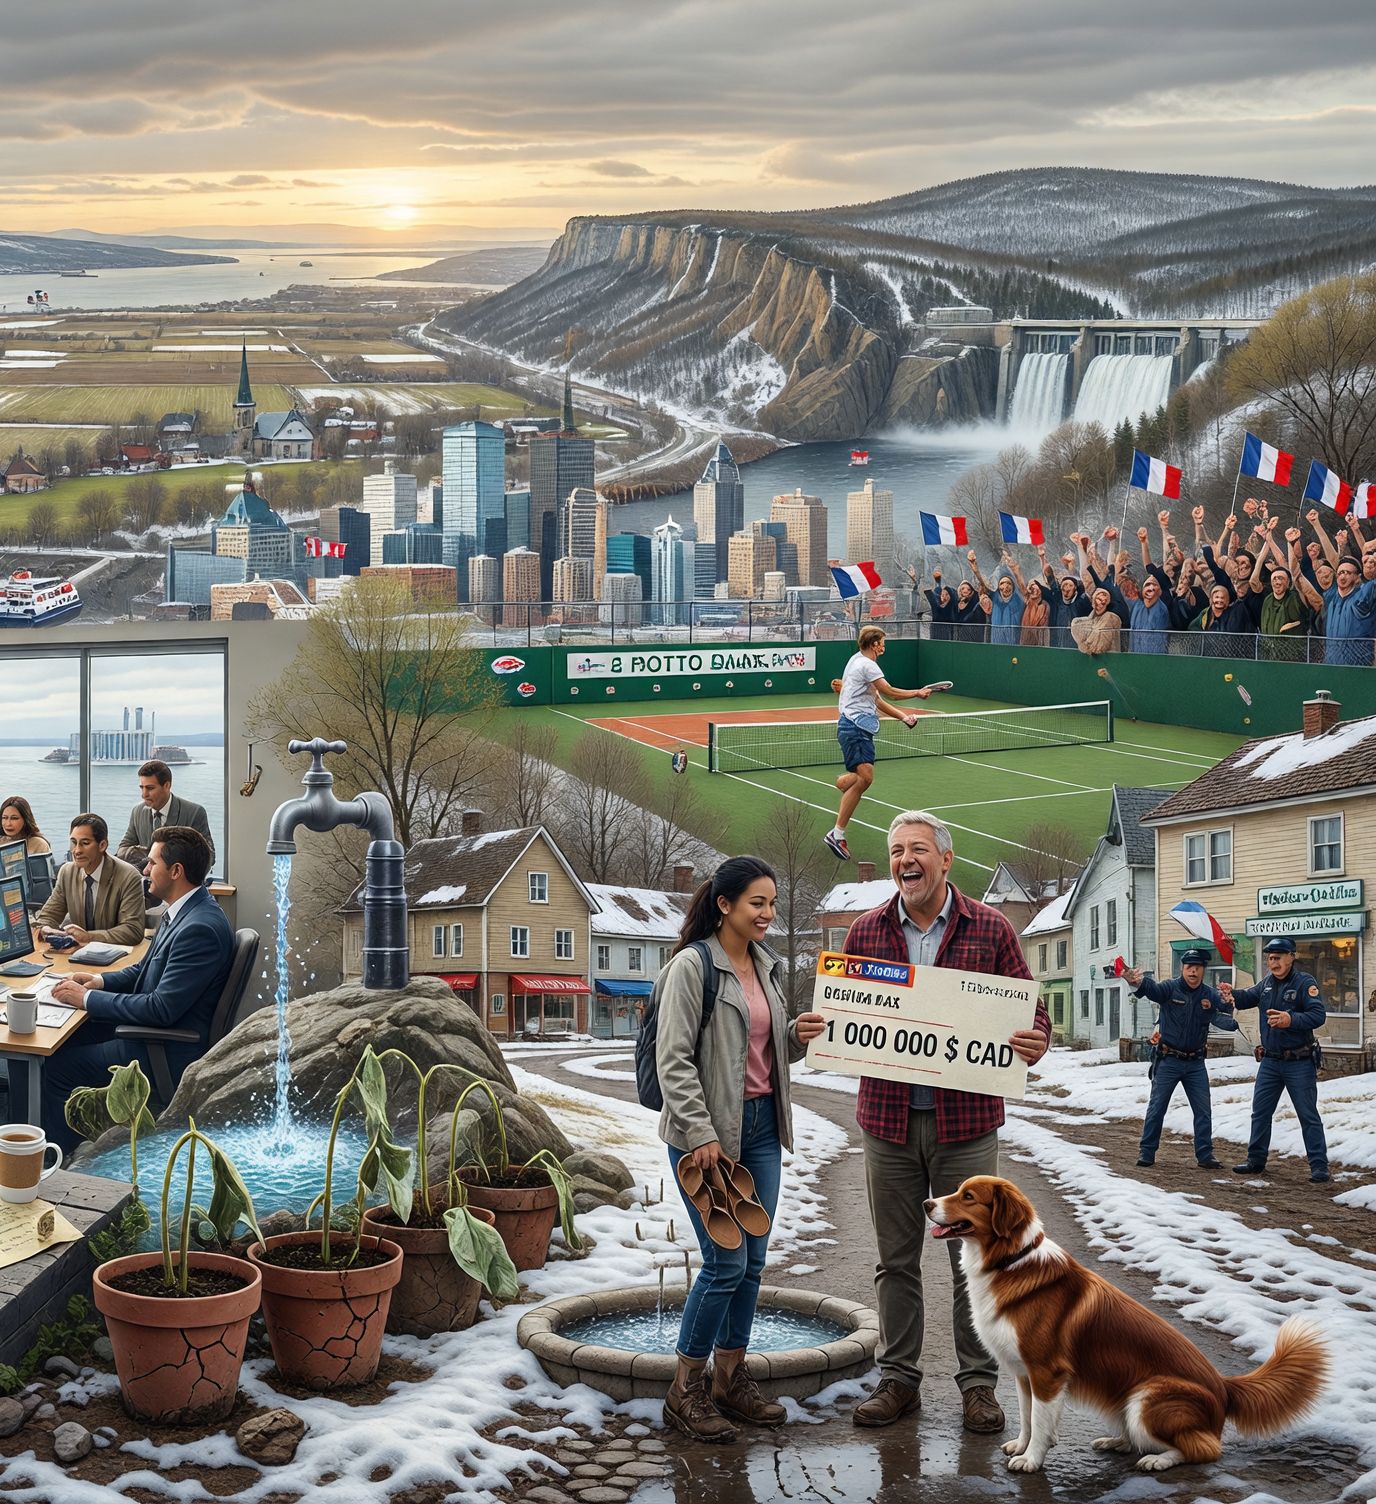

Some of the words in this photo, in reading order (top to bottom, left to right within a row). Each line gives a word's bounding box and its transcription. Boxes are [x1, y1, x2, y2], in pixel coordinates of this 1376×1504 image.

[826, 1019, 836, 1043] 1
[844, 1021, 887, 1050] 000
[893, 1028, 938, 1058] 000
[944, 1034, 959, 1064] $
[965, 1039, 1014, 1069] CAD
